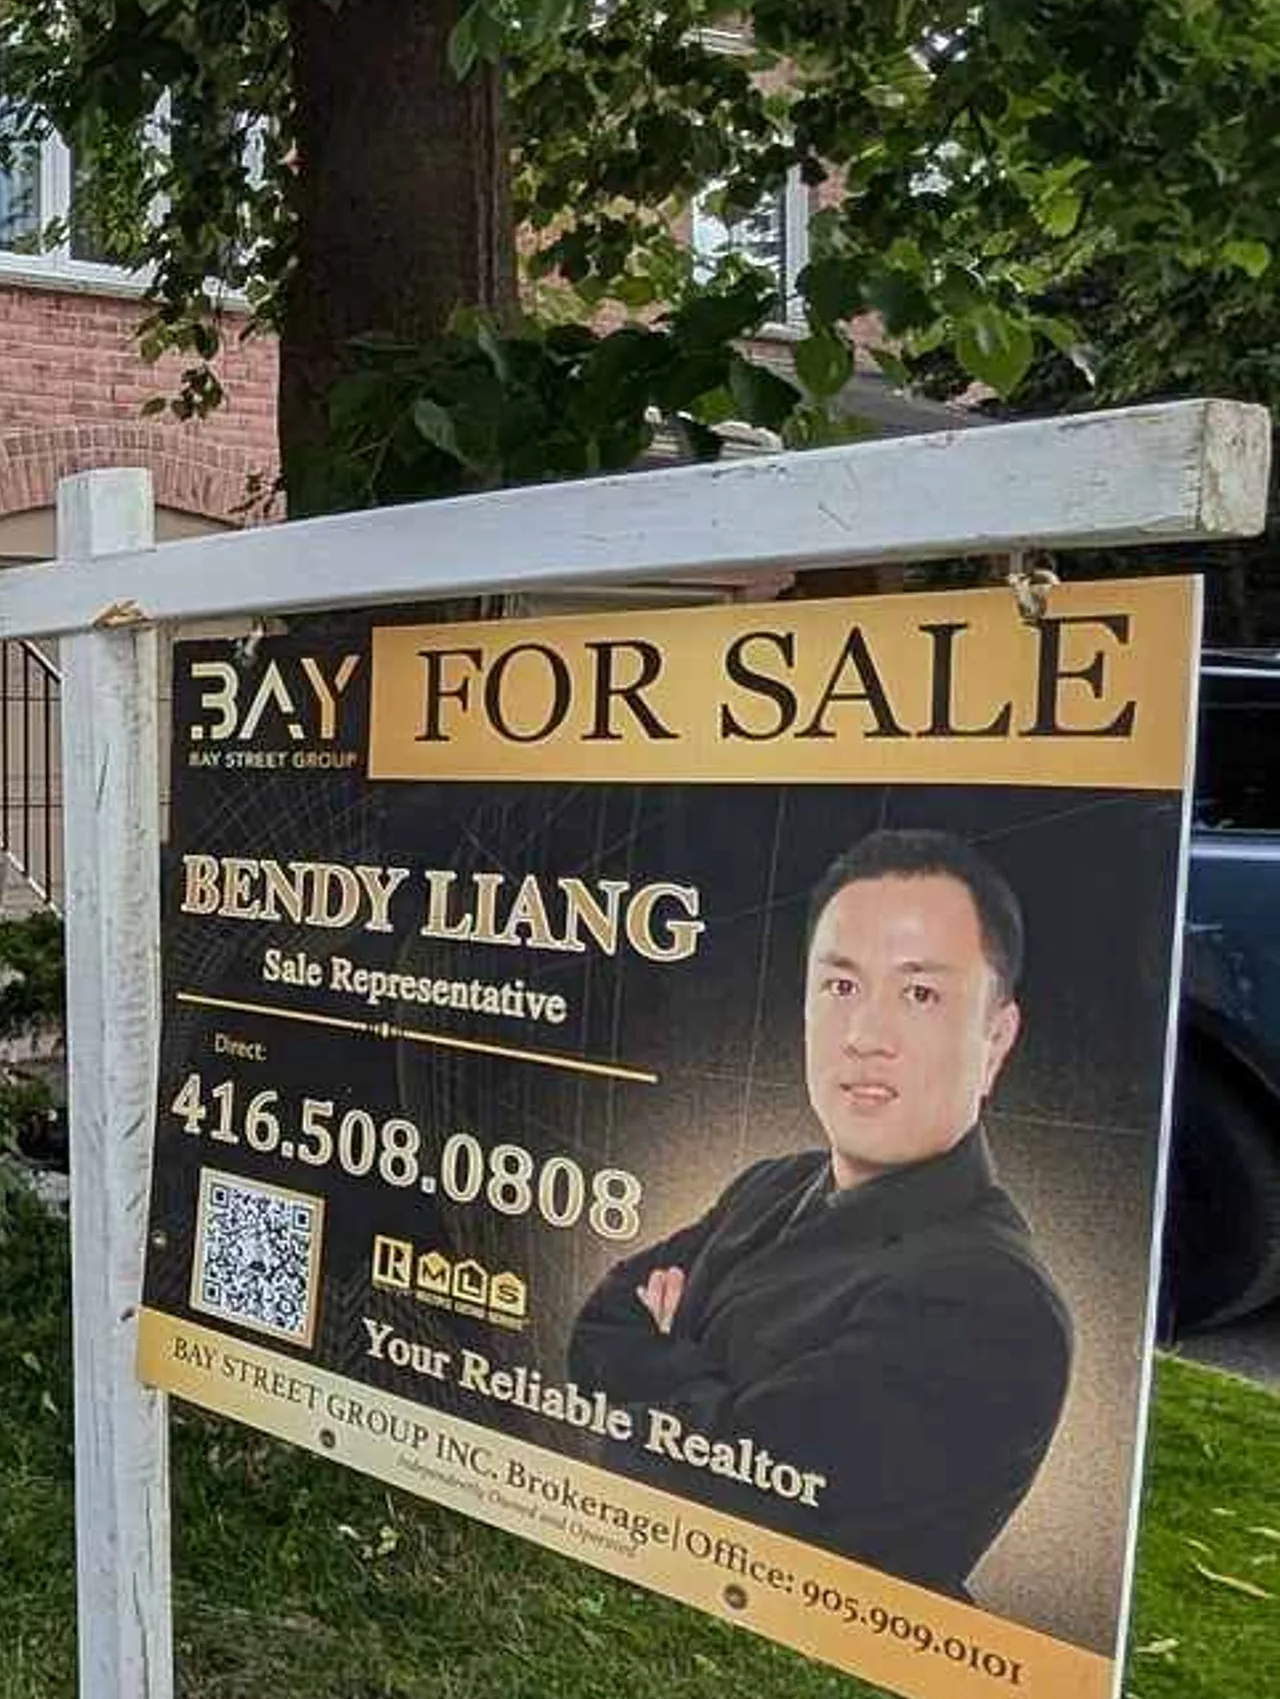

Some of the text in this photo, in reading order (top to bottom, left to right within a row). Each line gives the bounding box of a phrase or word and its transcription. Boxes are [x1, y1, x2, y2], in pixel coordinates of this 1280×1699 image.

[191, 655, 361, 739] BAY
[414, 614, 1138, 743] FOR SALE
[189, 751, 359, 768] BAY STREET GROUP
[180, 854, 705, 961] BENDY LIANG
[263, 948, 568, 1025] Sale Representative
[214, 1032, 268, 1061] Direct:
[171, 1072, 643, 1241] 416.508.0808
[361, 1317, 452, 1382] Your
[458, 1346, 633, 1441] Reliable
[645, 1408, 828, 1507] Realtor
[172, 1336, 218, 1370] BAY
[222, 1356, 319, 1409] STREET
[327, 1392, 430, 1451] GROUP
[436, 1433, 499, 1480] INC.
[802, 1578, 1027, 1687] 905.909.0101
